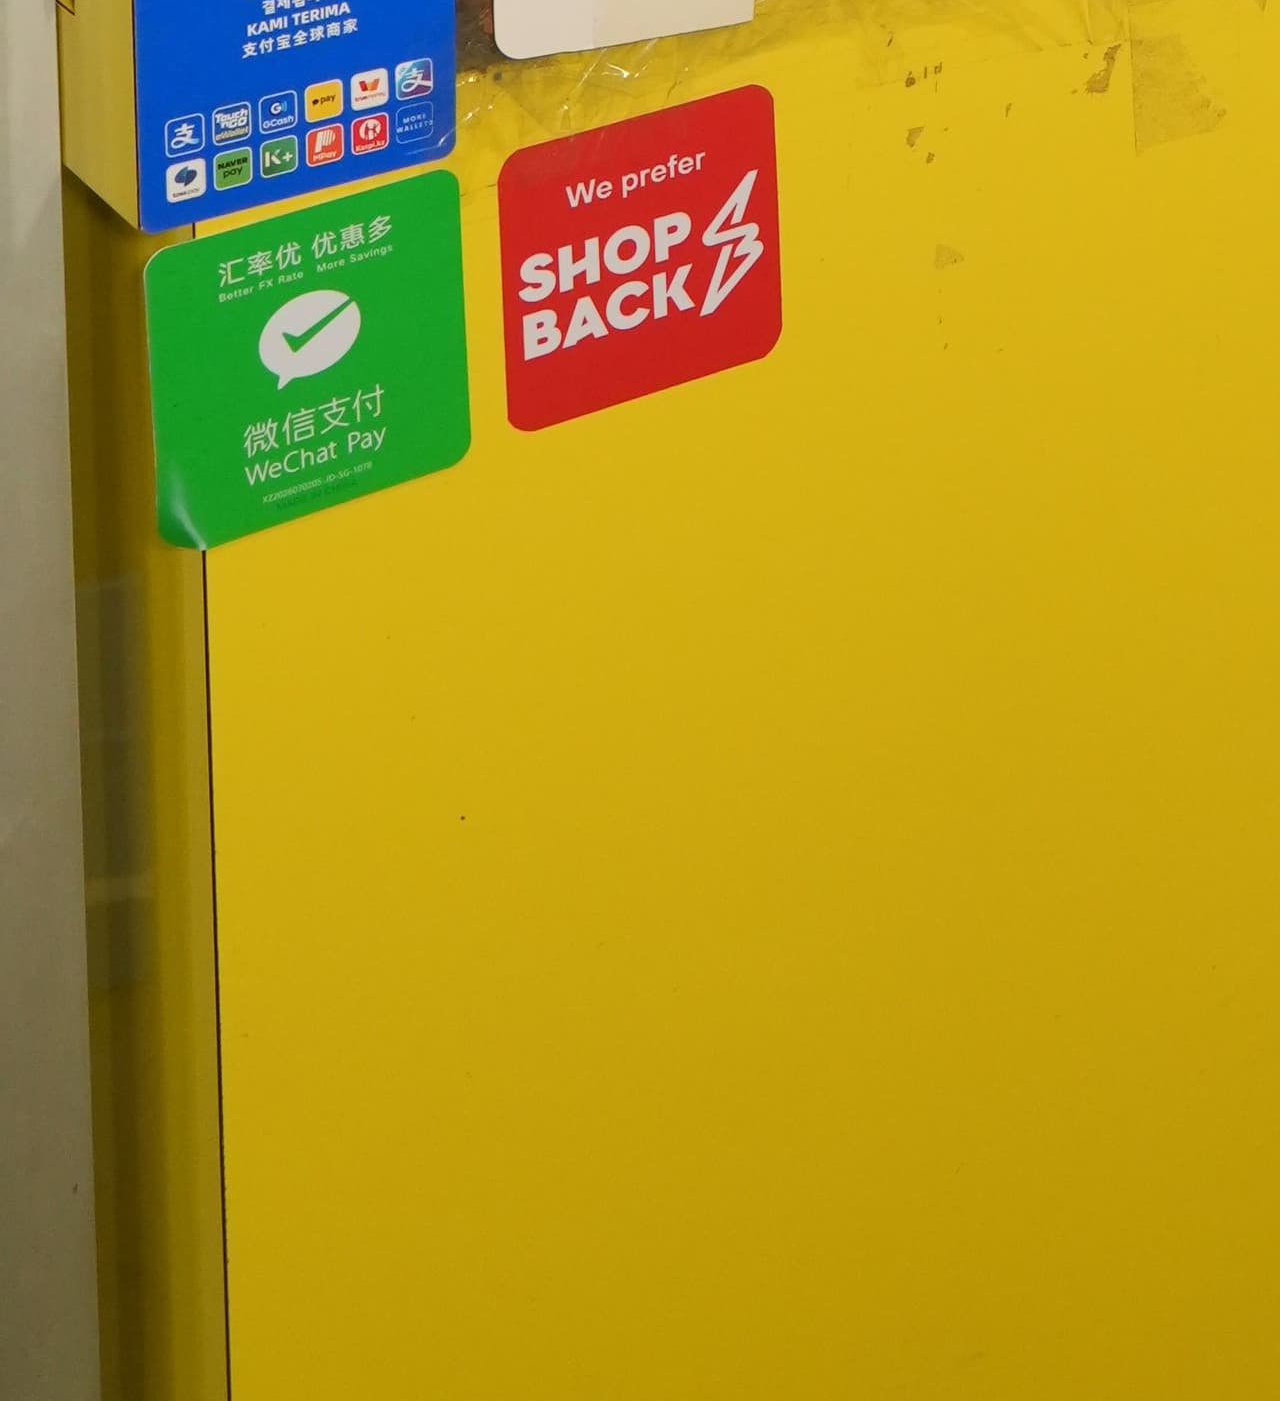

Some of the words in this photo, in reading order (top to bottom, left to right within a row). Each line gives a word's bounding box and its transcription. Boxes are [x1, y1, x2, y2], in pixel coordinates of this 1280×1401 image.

[242, 18, 358, 59] 支付宝全球商家
[247, 18, 288, 37] KAMI
[292, 2, 350, 27] TERIMA
[263, 116, 294, 129] GCash
[319, 92, 336, 105] pay
[217, 156, 249, 170] NAVER
[223, 166, 244, 179] pay
[565, 178, 613, 207] We
[621, 152, 706, 198] prefer
[219, 241, 302, 287] 汇率优
[311, 215, 392, 259] 优惠多
[219, 287, 253, 303] Better
[258, 279, 273, 290] FX
[316, 259, 345, 272] More
[350, 244, 393, 263] Savings
[518, 212, 692, 302] SHOP
[522, 263, 696, 361] BACK
[243, 383, 385, 458] 微信支付
[244, 442, 338, 486] WeChat
[347, 427, 386, 453] Pay
